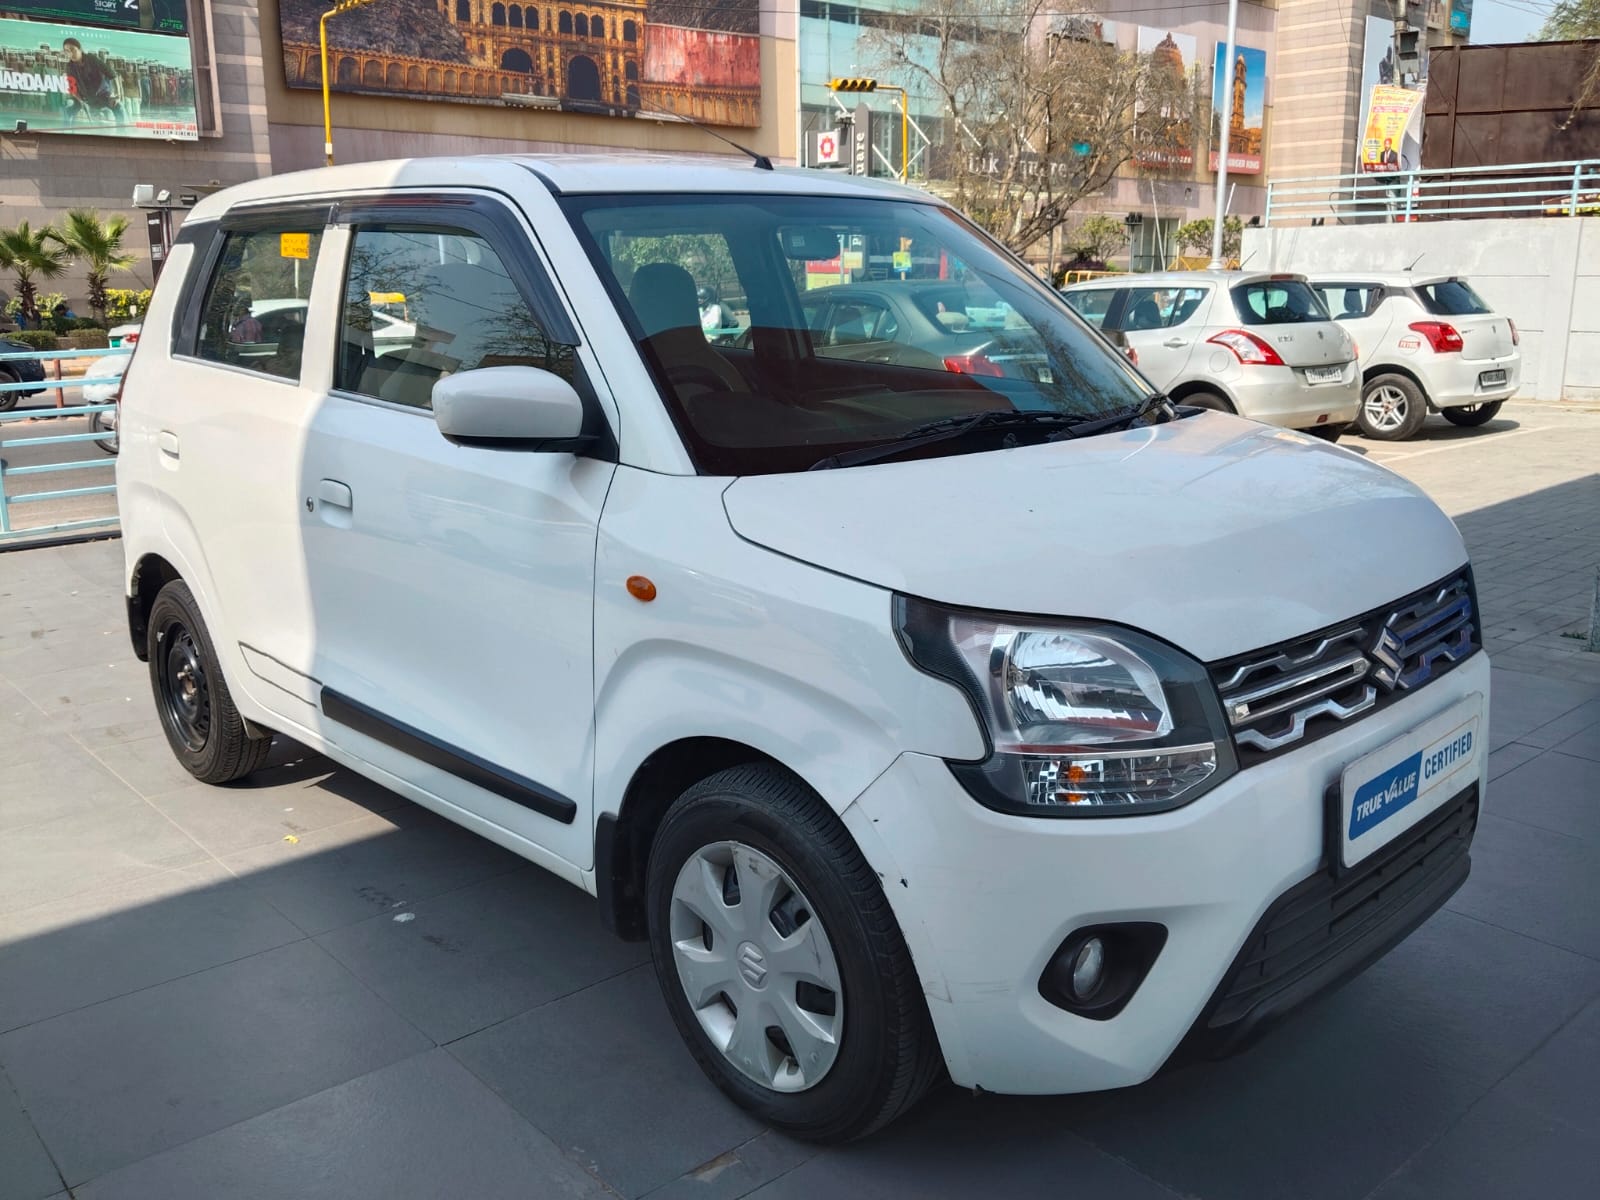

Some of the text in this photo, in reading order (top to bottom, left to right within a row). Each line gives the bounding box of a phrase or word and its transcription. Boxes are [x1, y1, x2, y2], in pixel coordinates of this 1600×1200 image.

[1356, 731, 1472, 822] TRUE VALUE CERTIFIED
